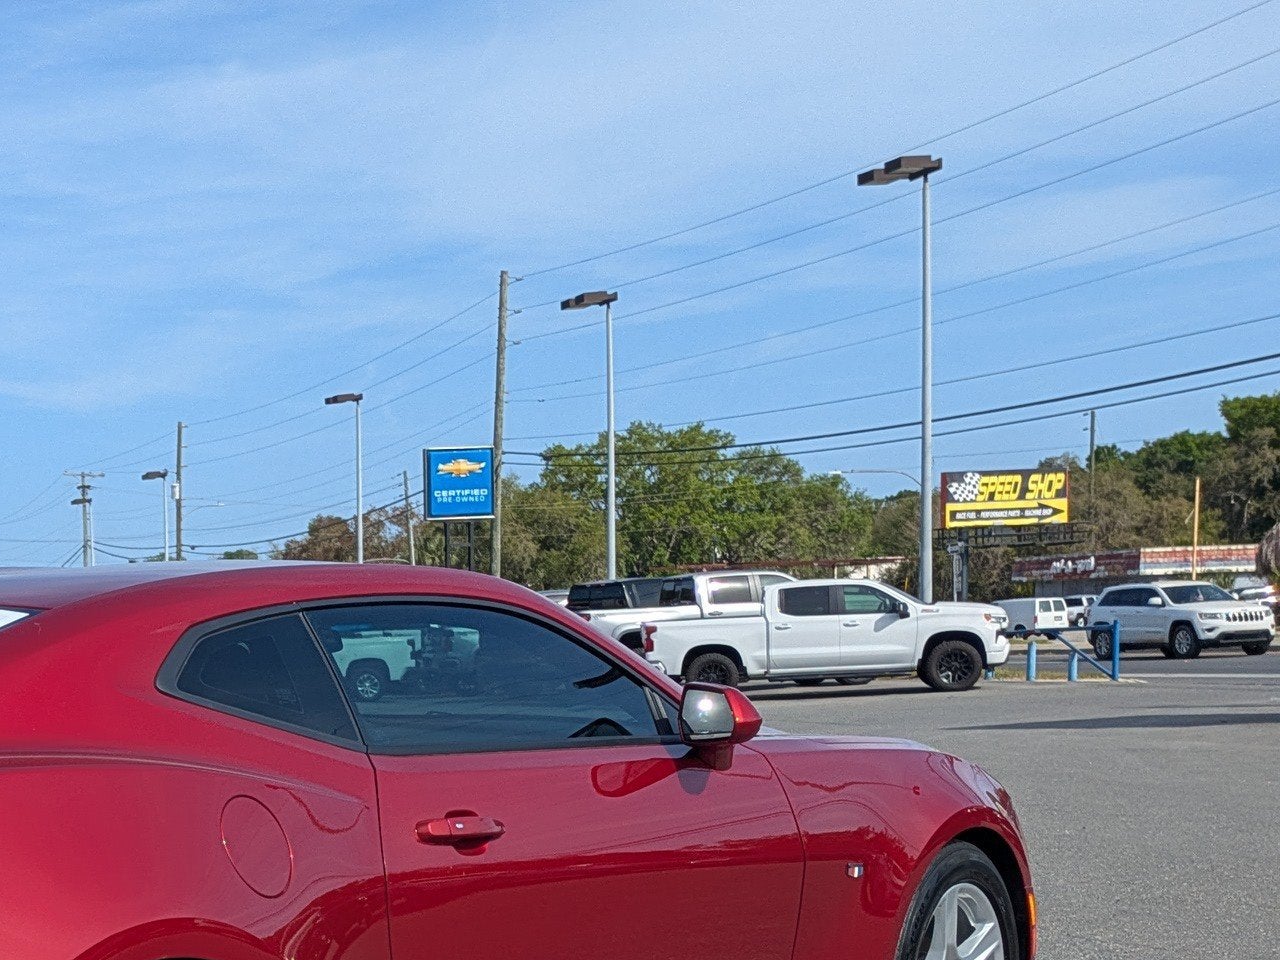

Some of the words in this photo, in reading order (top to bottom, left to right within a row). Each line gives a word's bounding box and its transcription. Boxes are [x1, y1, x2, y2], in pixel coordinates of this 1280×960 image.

[434, 489, 488, 497] CERTIFIED
[976, 474, 1022, 502] SPEED
[1025, 472, 1065, 499] SHOP
